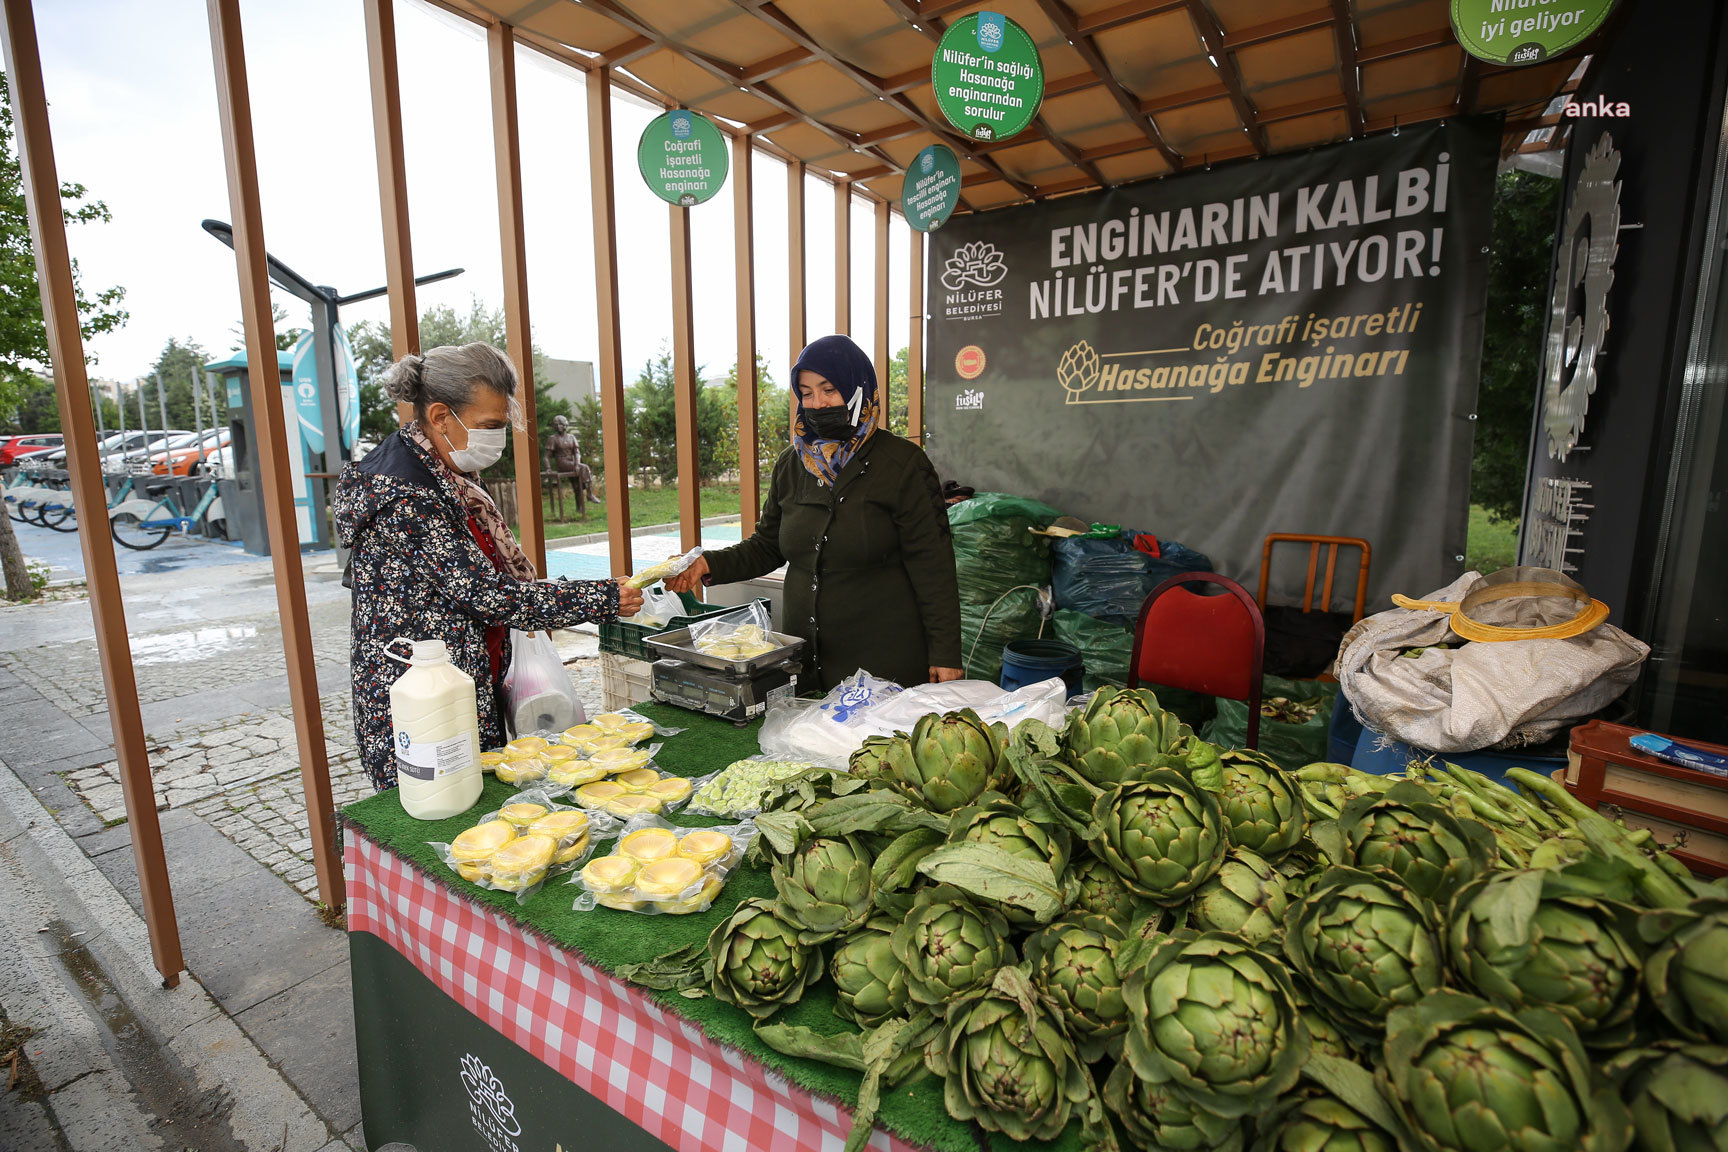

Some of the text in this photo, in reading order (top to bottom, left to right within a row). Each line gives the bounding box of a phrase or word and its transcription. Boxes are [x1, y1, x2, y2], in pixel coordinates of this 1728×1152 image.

[1480, 9, 1586, 43] iyi geliyor
[960, 68, 1015, 92] Hasanağa
[996, 61, 1034, 80] sağlığı
[948, 86, 1023, 108] enginarından
[964, 105, 1006, 121] sorulur
[664, 139, 702, 153] Coğrafi
[666, 154, 702, 168] işaretli
[659, 166, 711, 180] Hasanağa
[665, 180, 708, 193] enginarı
[907, 188, 928, 206] tescilli
[916, 189, 947, 211] Hasanağa
[919, 201, 946, 220] enginarı
[1050, 151, 1451, 268] ENGİNARIN KALBİ
[1029, 227, 1444, 320] NİLÜFER'DE ATIYOR!
[946, 289, 1003, 304] NİLÜFER
[946, 300, 1002, 315] BELEDİYESİ
[1192, 302, 1424, 355] Coğrafi işaretli
[1097, 345, 1410, 394] Hasanağa Enginarı
